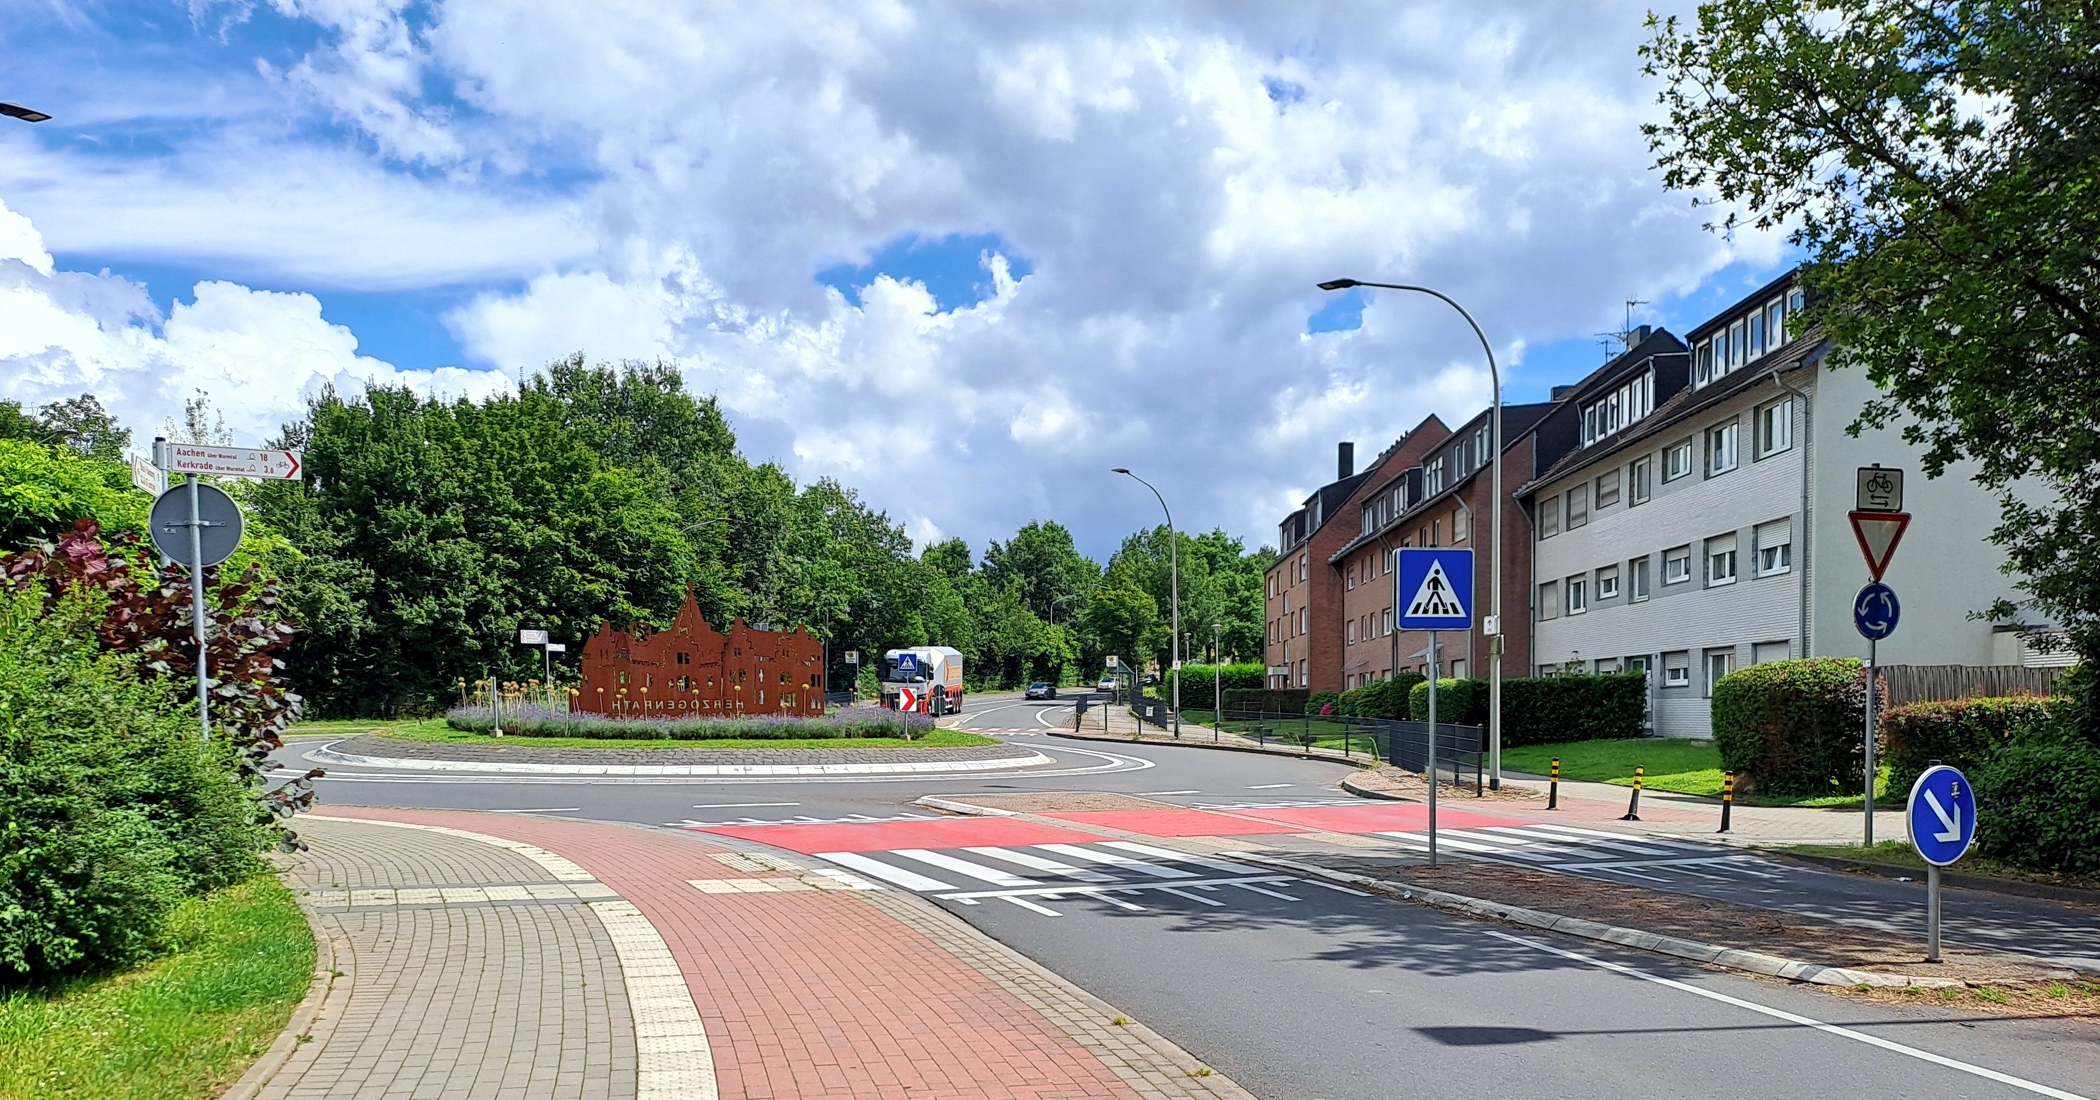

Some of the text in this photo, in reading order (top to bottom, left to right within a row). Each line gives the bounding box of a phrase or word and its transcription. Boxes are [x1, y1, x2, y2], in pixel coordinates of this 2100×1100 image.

[176, 448, 205, 457] Aachen
[260, 453, 268, 461] 18
[177, 460, 213, 470] Kerkrade
